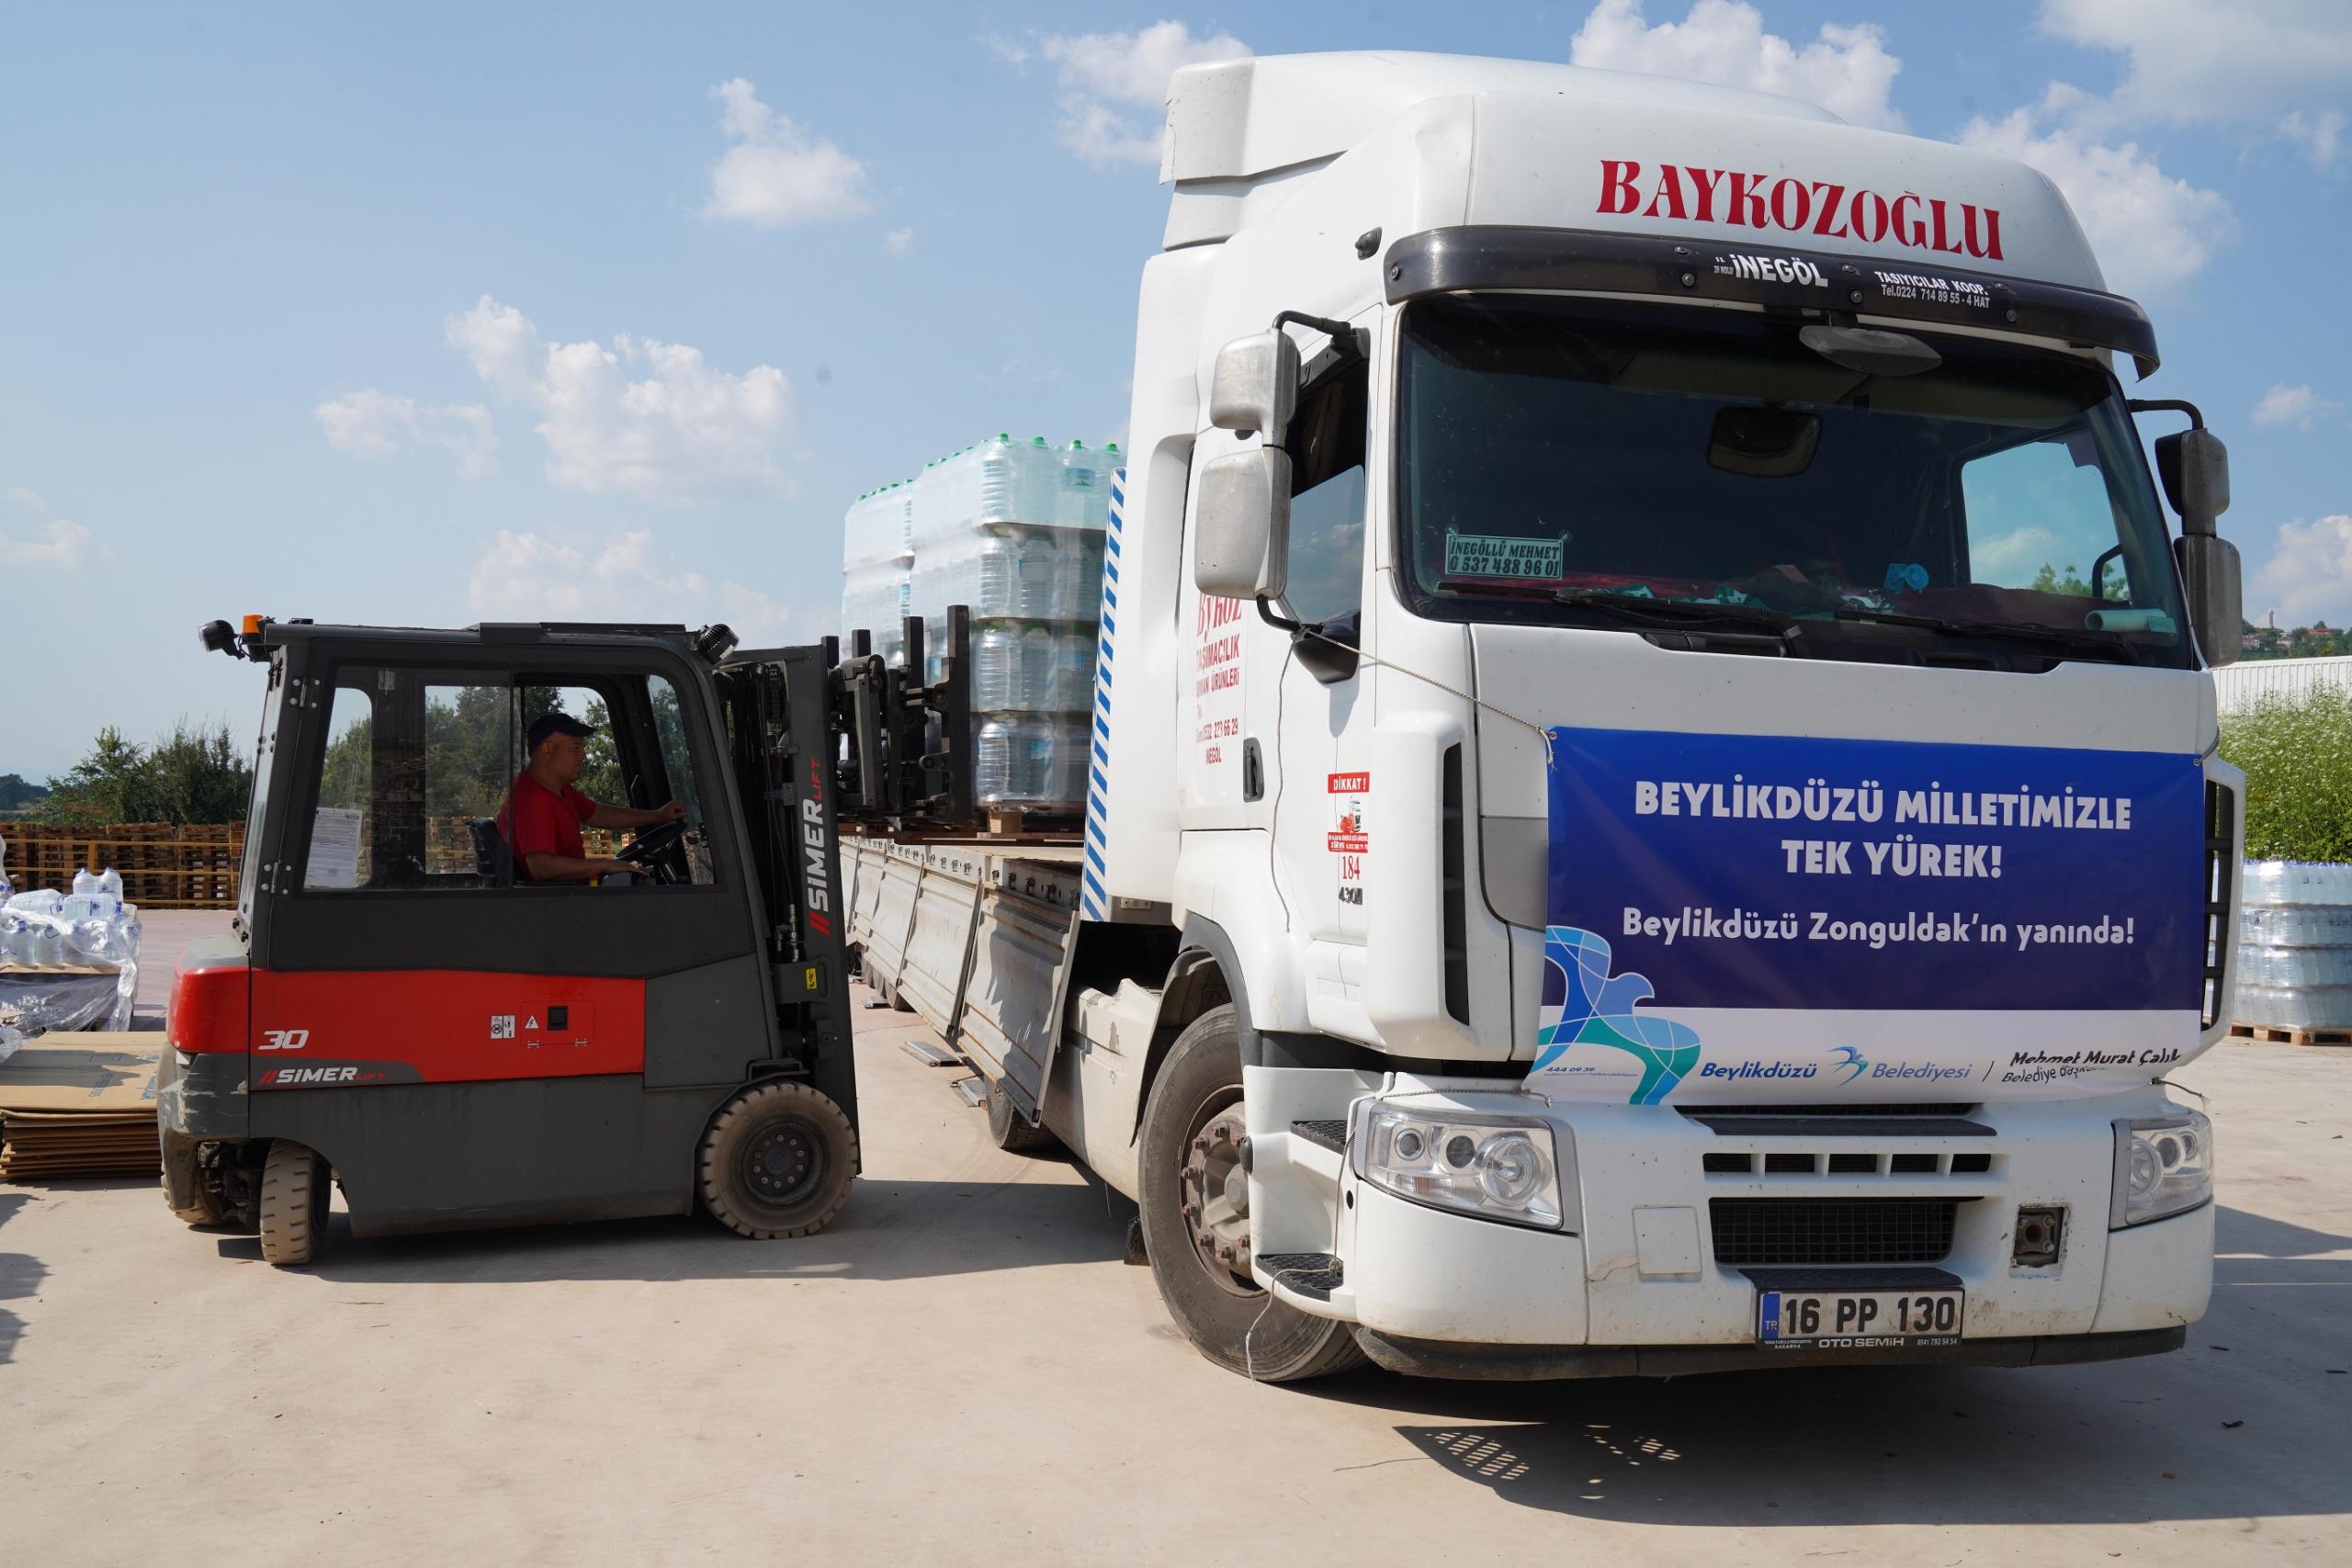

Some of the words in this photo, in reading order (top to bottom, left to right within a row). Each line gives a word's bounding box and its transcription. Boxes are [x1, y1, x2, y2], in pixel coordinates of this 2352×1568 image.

[1596, 160, 2004, 260] BAYKOZOĞLU
[1921, 288, 1936, 301] 714
[1938, 289, 1948, 302] 89
[1950, 292, 1961, 304] 55
[1966, 295, 1972, 305] 4
[1973, 296, 1990, 308] HAT
[1509, 544, 1560, 559] MEHMET
[1462, 558, 1489, 573] 537
[1523, 559, 1542, 576] 96
[1544, 560, 1559, 577] 01
[1333, 776, 1362, 791] DİKKAT
[1635, 773, 1883, 822] BEYLİKDÜZÜ
[1894, 781, 2132, 830] MİLLETİMİZLE
[1781, 840, 1852, 875] TEK
[1862, 833, 2003, 879] YÜREK!
[1341, 855, 1360, 880] 184
[1623, 906, 1799, 945] Beylikdüzü
[2018, 914, 2135, 952] yanında!
[258, 1029, 310, 1051] 30
[2009, 1050, 2080, 1067] Mehmet
[2083, 1050, 2134, 1065] Murat
[1701, 1062, 1817, 1081] Beylikdüzü
[1871, 1062, 1973, 1082] Belediyesi
[2001, 1066, 2057, 1084] Belediye
[1786, 1298, 1821, 1334] 16
[1836, 1298, 1878, 1333] PP
[1898, 1296, 1955, 1332] 130
[1818, 1338, 1852, 1348] OTO
